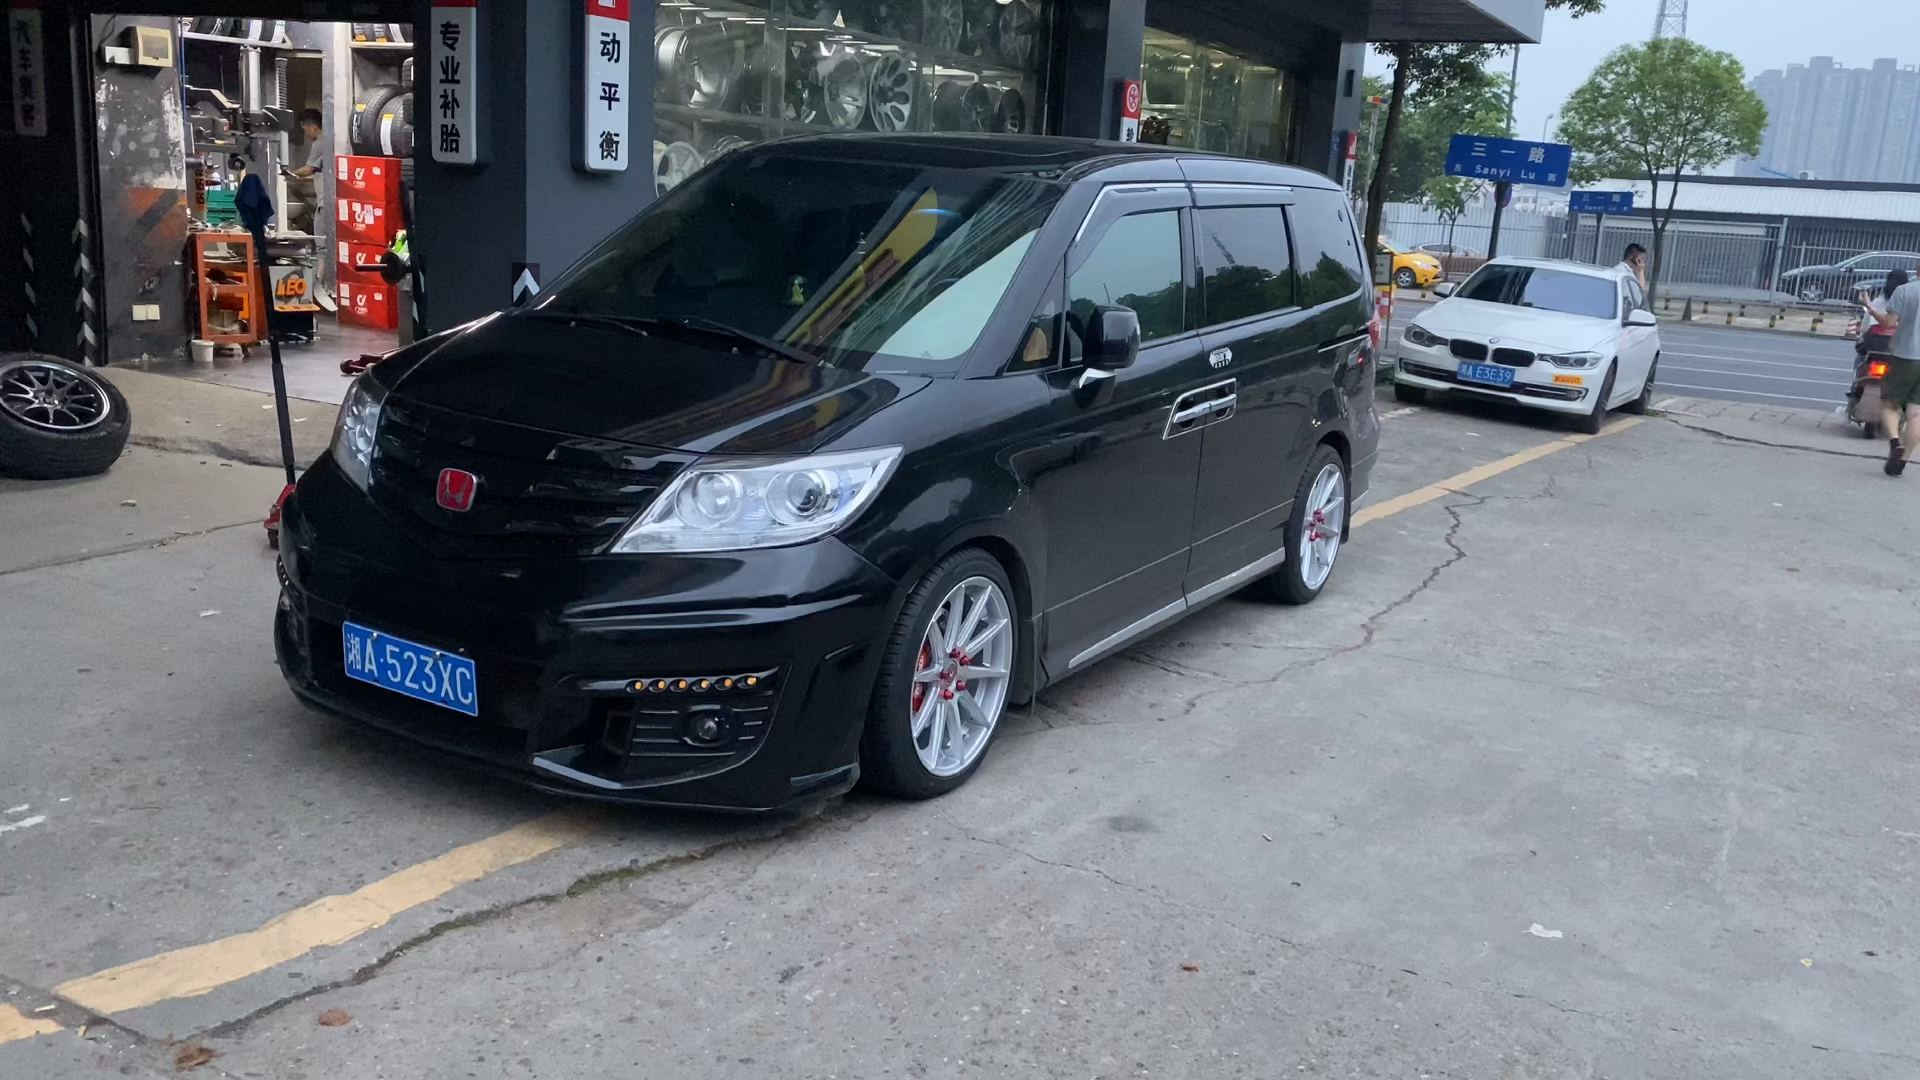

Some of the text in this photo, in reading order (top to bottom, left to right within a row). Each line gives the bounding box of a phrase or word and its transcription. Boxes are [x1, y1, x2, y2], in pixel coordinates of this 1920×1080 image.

[439, 20, 461, 154] 专业补胎
[599, 31, 620, 161] 动平衡
[1470, 142, 1546, 164] 三一路
[1474, 164, 1536, 180] Sanyi Lu
